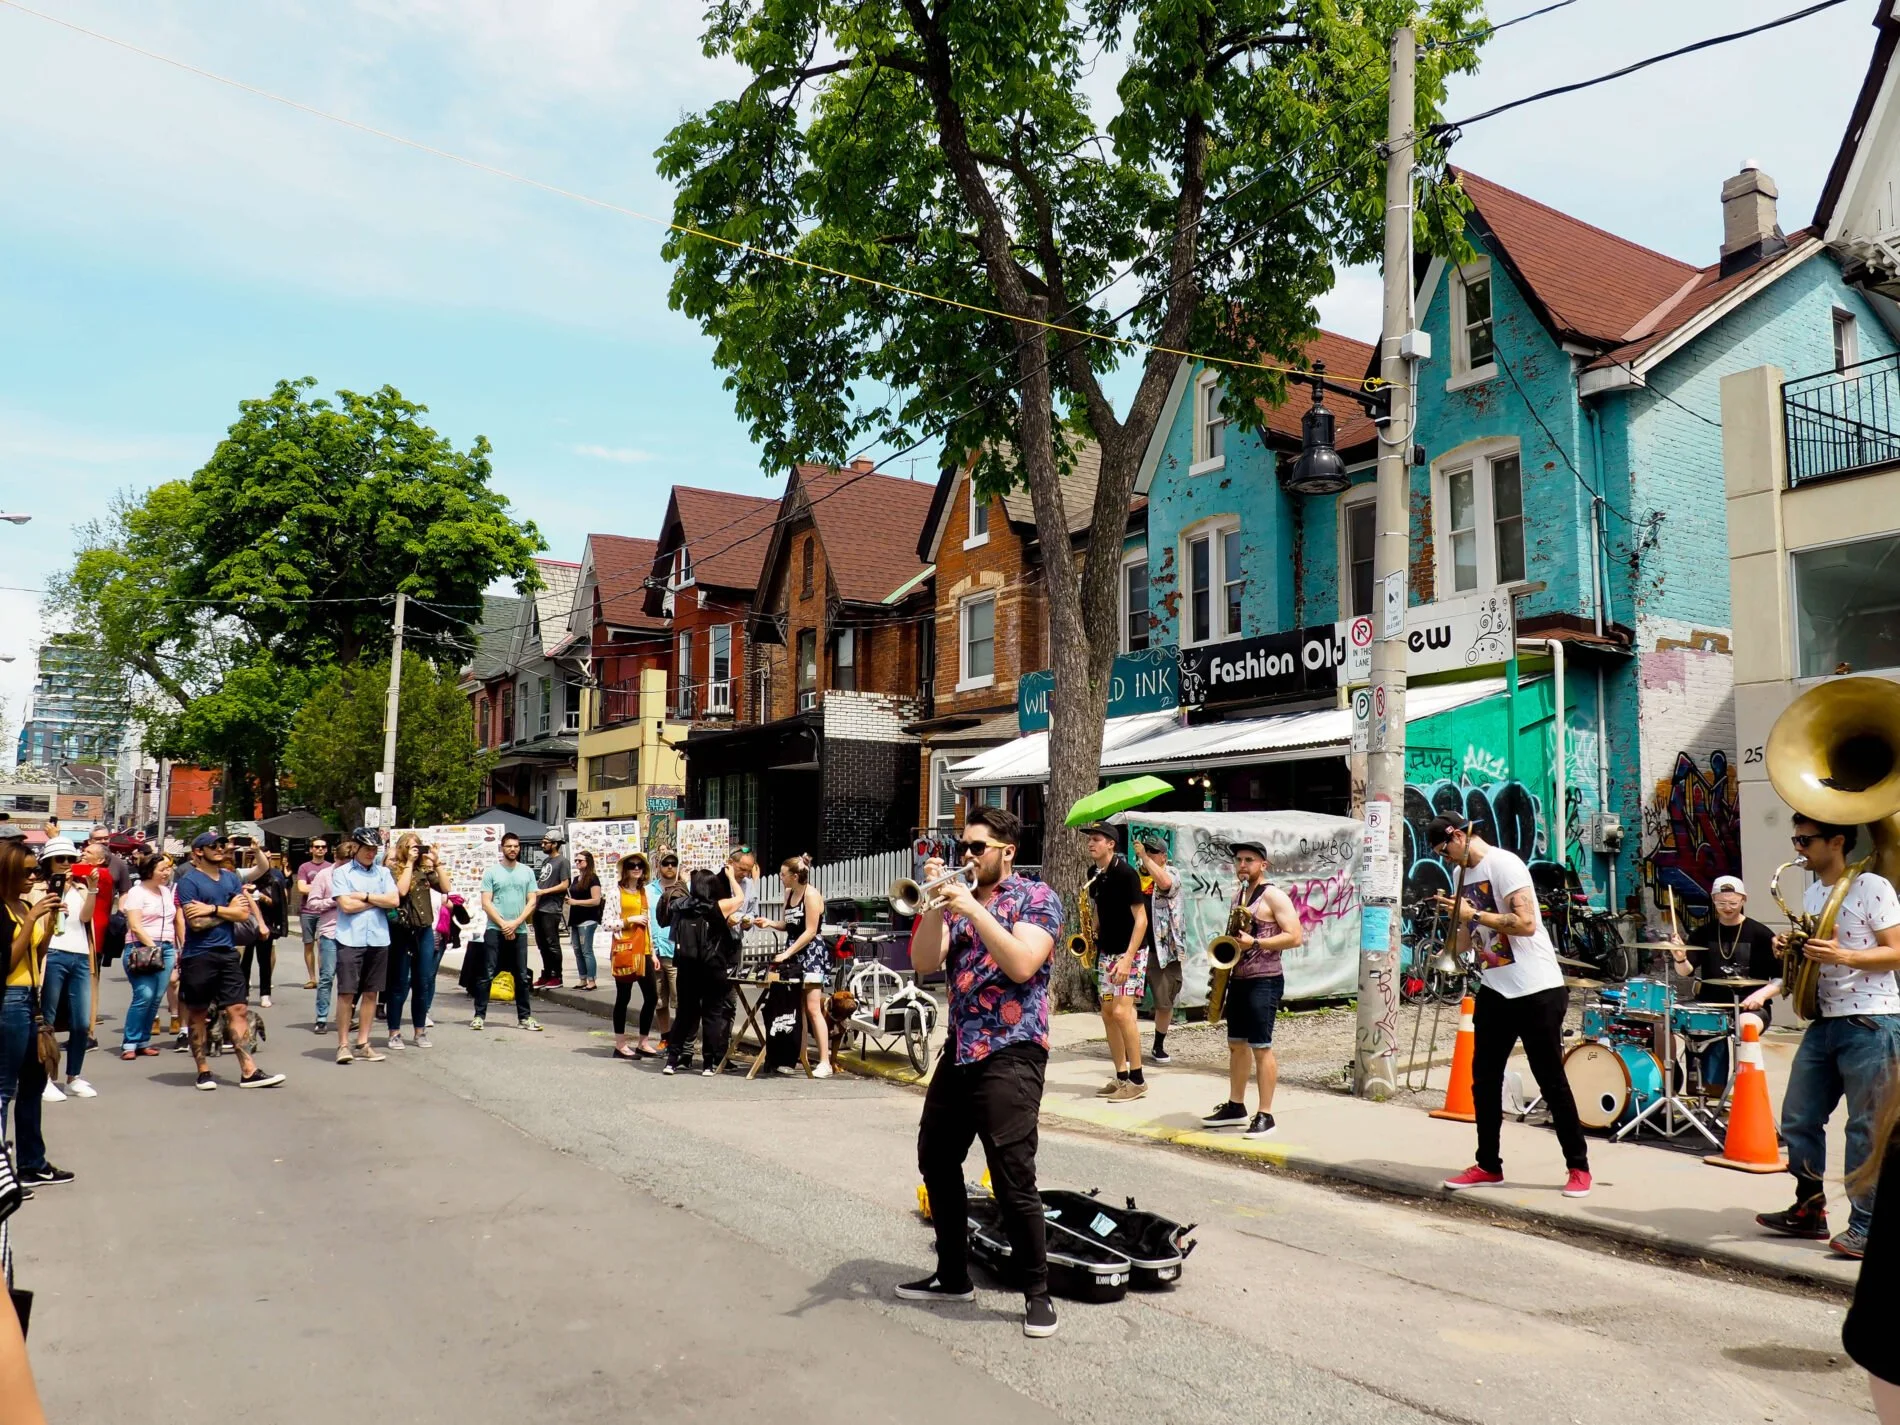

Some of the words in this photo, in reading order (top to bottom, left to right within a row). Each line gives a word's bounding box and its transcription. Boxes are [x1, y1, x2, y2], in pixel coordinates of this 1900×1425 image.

[1210, 648, 1295, 685] Fashion
[1301, 636, 1346, 670] Old
[1407, 625, 1451, 653] ew
[1353, 649, 1358, 657] IN
[1360, 646, 1372, 656] THIS
[1355, 658, 1369, 668] LANE
[1135, 667, 1174, 698] INK
[1743, 746, 1764, 764] 25
